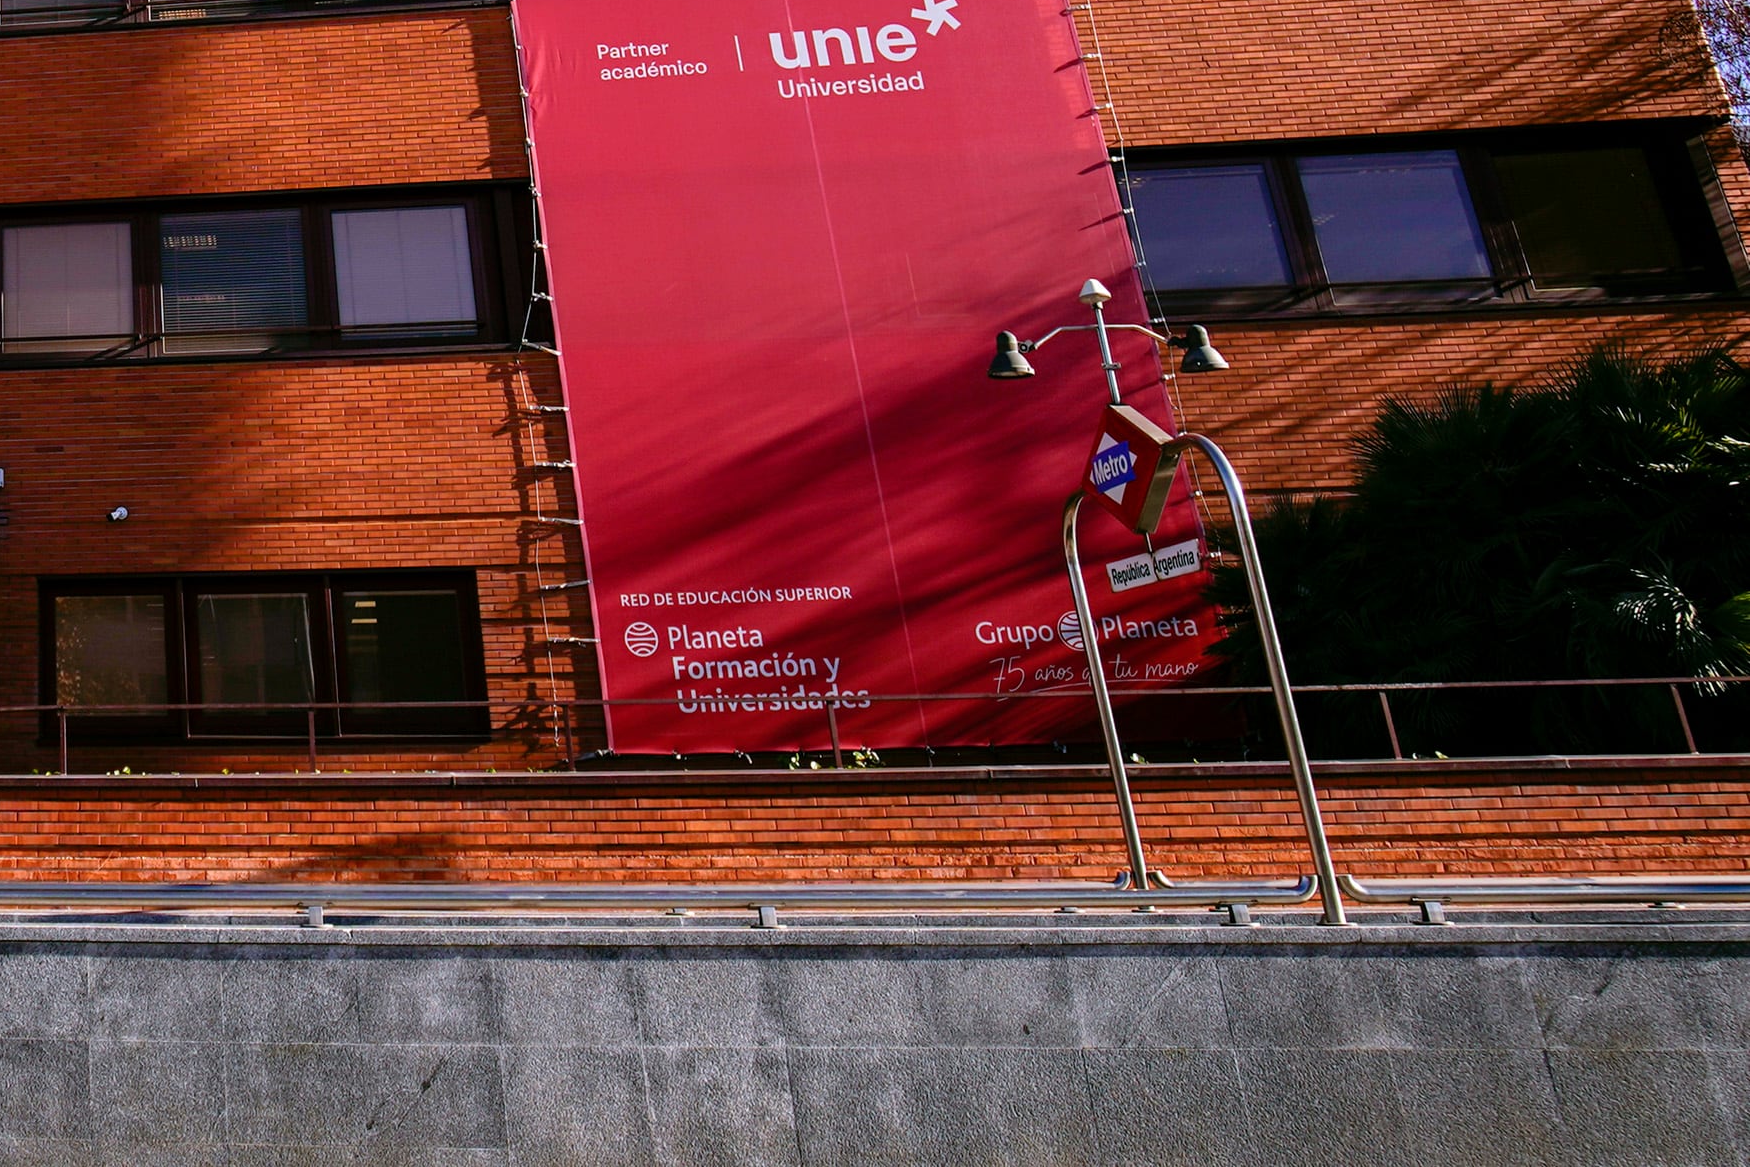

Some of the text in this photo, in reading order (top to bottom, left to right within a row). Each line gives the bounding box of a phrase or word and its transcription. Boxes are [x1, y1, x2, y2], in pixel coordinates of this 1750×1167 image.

[596, 40, 670, 60] Partner
[600, 58, 708, 81] académico
[777, 71, 925, 99] Universidad
[1093, 453, 1129, 486] Metro
[1111, 549, 1196, 585] República Argentina
[620, 586, 853, 607] RED DE EDUCACIÓN SUPERIOR
[667, 625, 764, 650] Planeta
[975, 615, 1199, 650] Grupo Planeta
[672, 652, 841, 683] Formación y
[989, 655, 1026, 696] 75
[1034, 664, 1075, 682] años
[1108, 654, 1139, 680] tu
[1145, 662, 1200, 680] mano
[676, 684, 872, 714] Universidades
